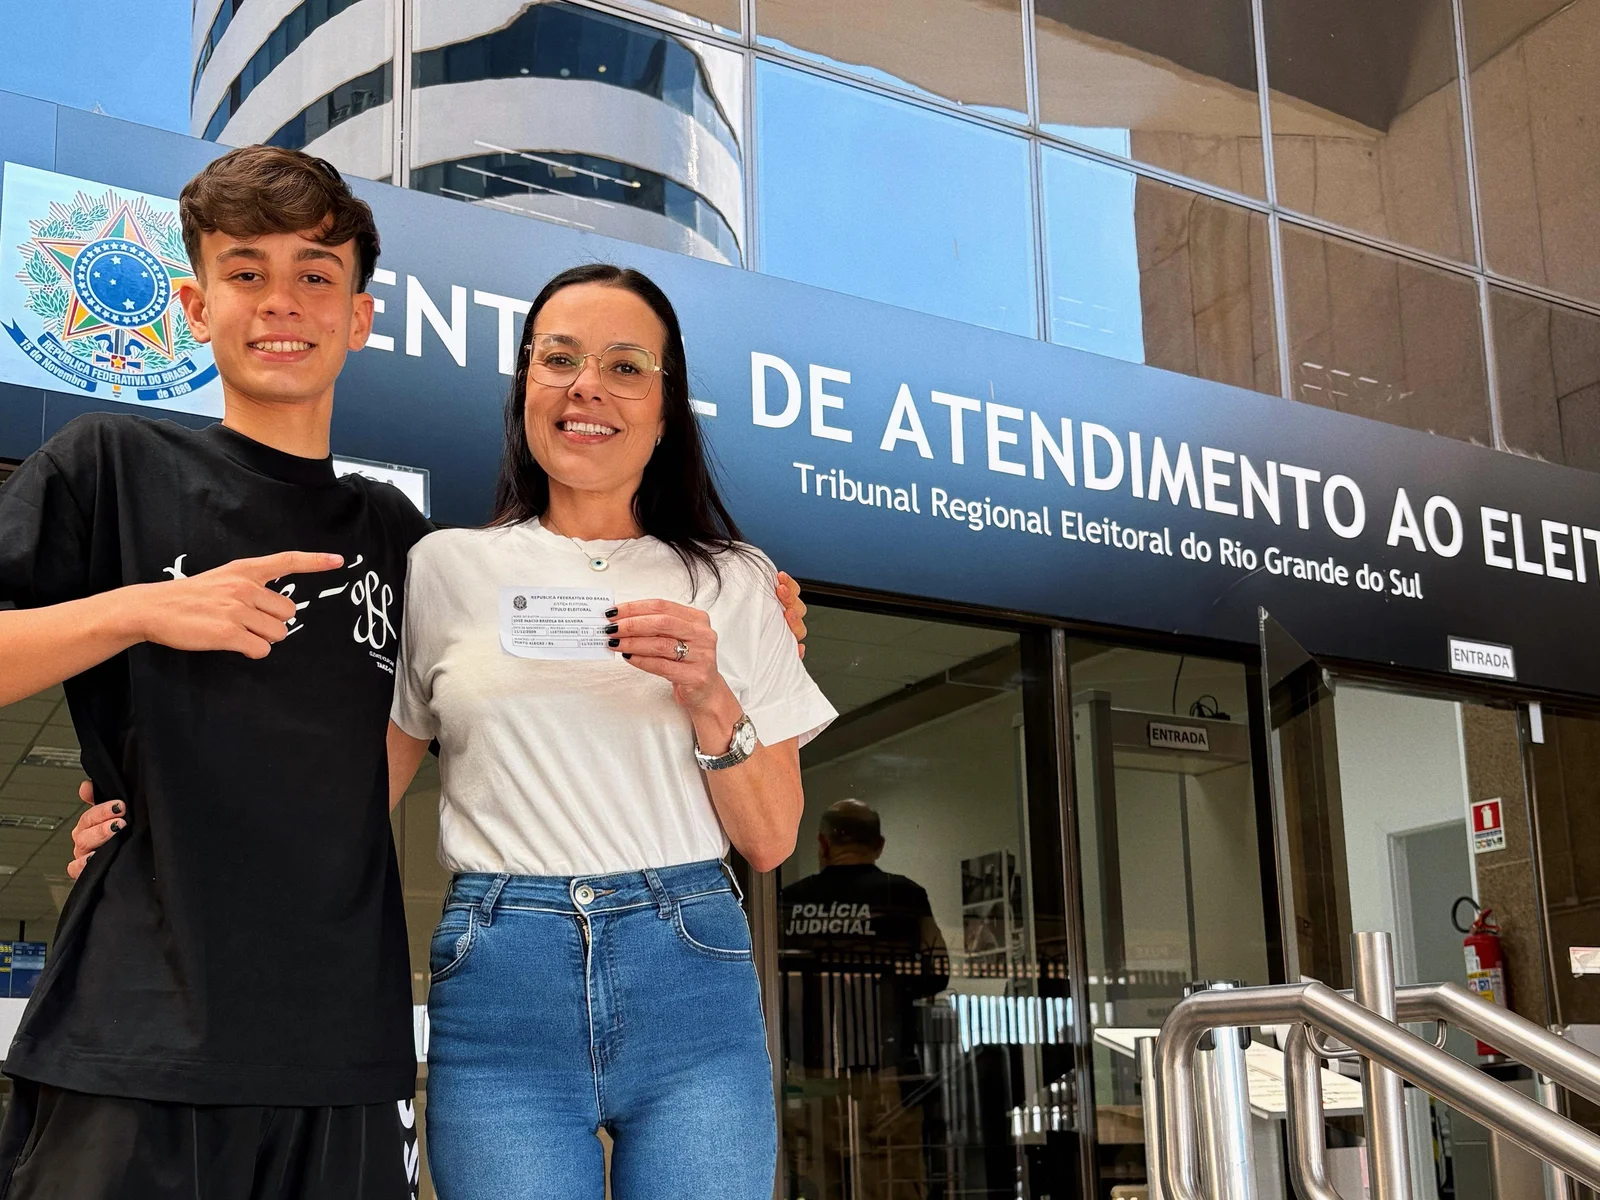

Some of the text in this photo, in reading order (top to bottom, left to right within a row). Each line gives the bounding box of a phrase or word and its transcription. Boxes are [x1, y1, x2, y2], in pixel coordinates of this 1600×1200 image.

[19, 338, 88, 389] 15 de Novembro
[92, 368, 147, 386] FEDERATIVA
[148, 375, 161, 385] DO
[162, 365, 193, 380] BRASIL
[156, 382, 192, 399] de 1889
[751, 350, 853, 443] DE
[879, 382, 1366, 539] ATENDIMENTO
[1386, 487, 1464, 558] AO
[792, 462, 1424, 600] Tribunal Regional Eleitoral do Rio Grande do Sul
[1454, 648, 1510, 669] ENTRADA
[1152, 728, 1206, 745] ENTRADA
[791, 901, 872, 919] POLÍCIA
[785, 919, 877, 936] JUDICIAL
